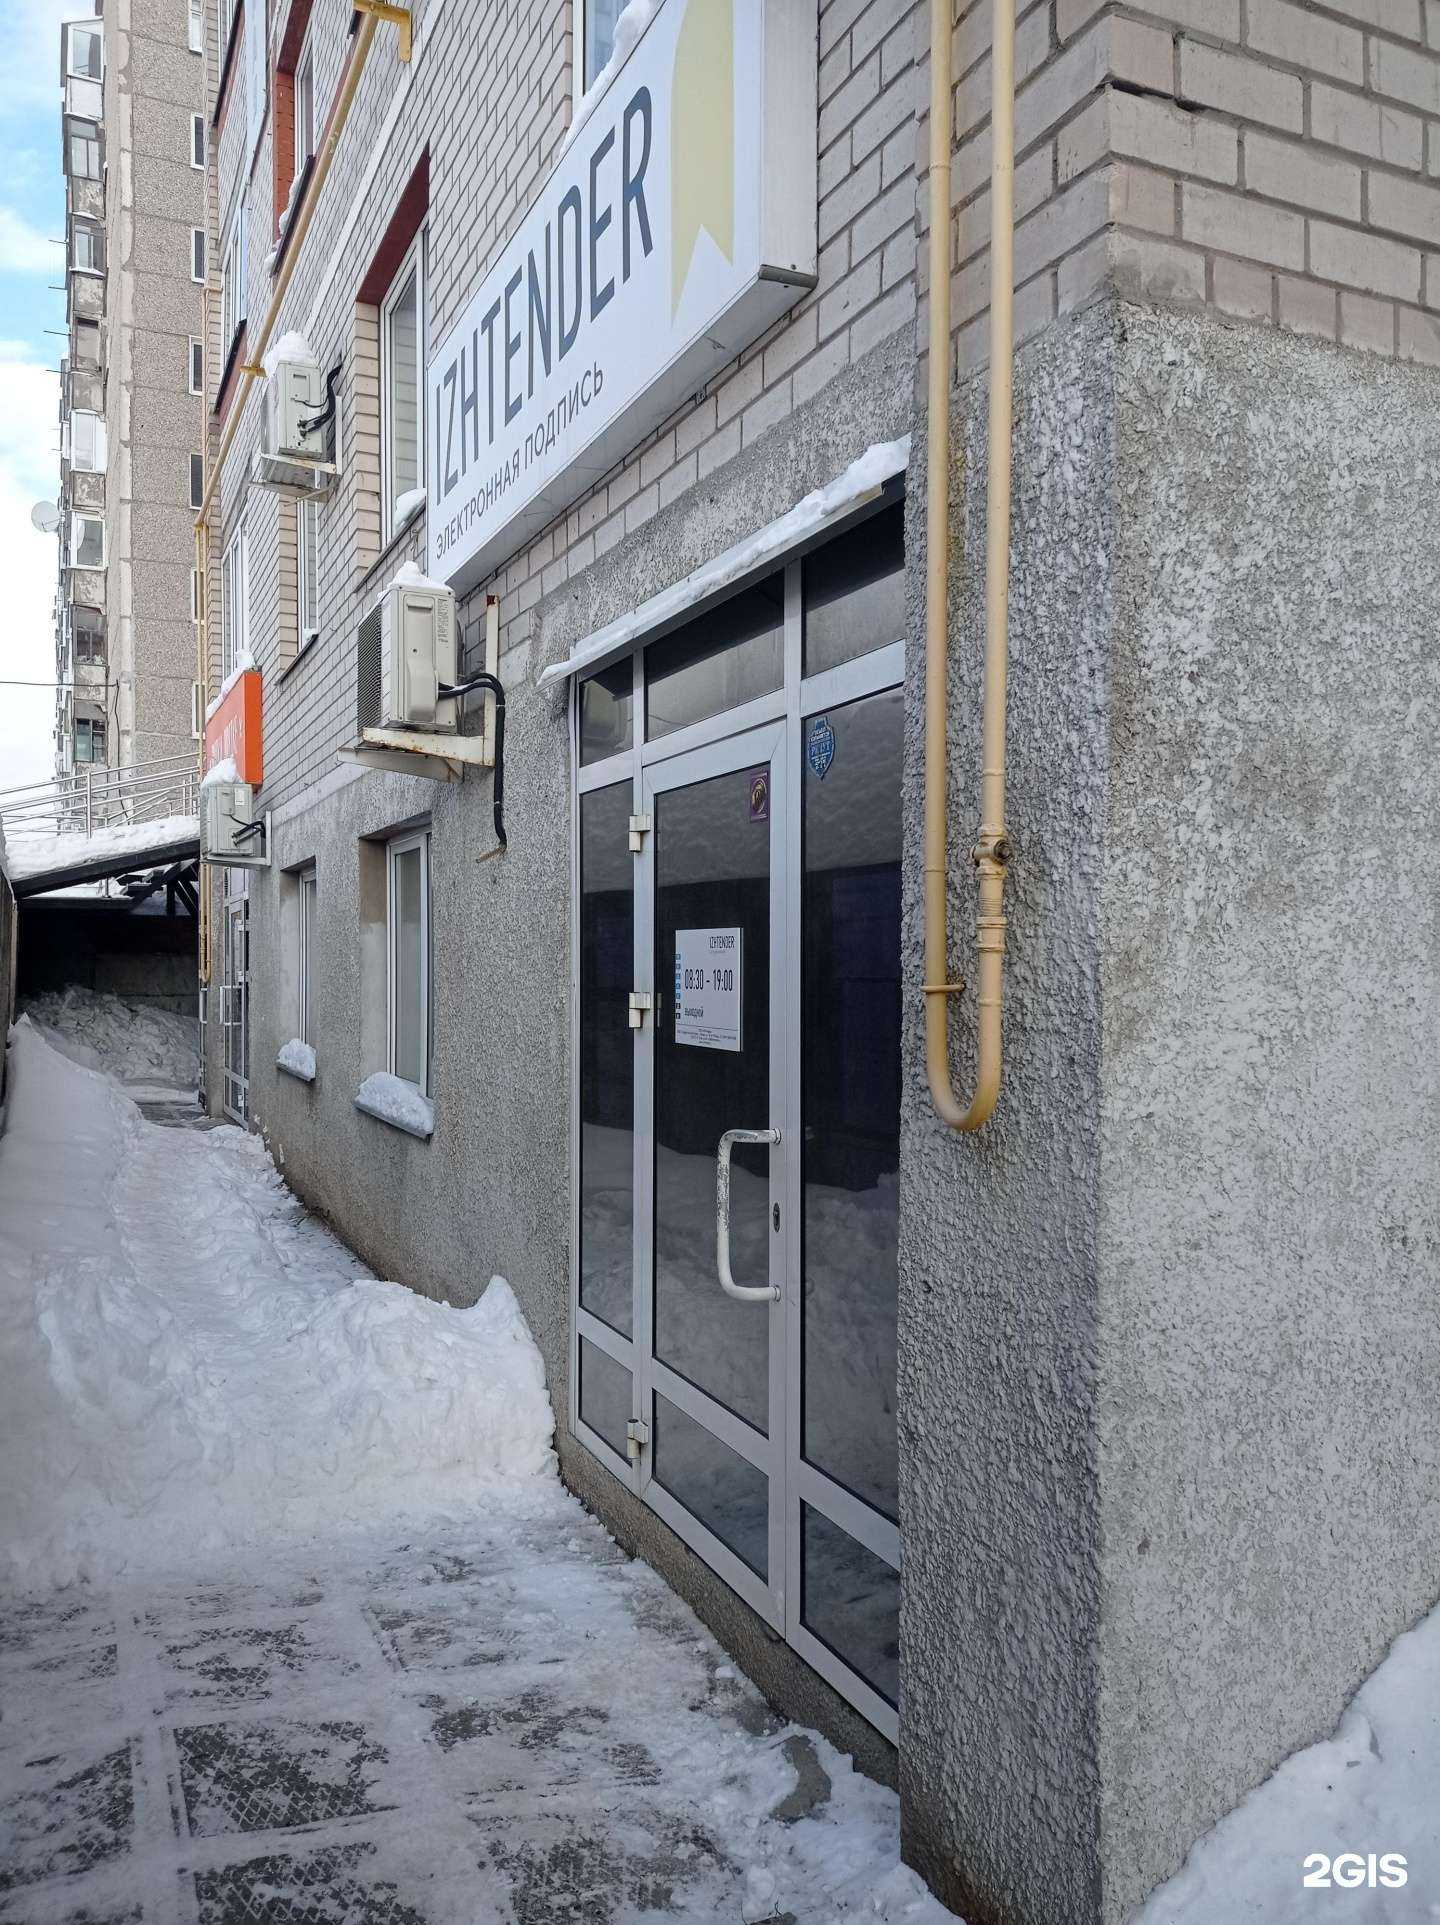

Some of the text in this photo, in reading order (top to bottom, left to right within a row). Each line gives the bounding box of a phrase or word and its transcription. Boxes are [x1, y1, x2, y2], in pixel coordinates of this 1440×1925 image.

[436, 85, 653, 506] IZHTENDER
[436, 360, 604, 560] ЭЛЕКТРОННАЯ ПОДПИСЬ
[684, 968, 704, 990] 08:30
[712, 969, 733, 992] 19:00
